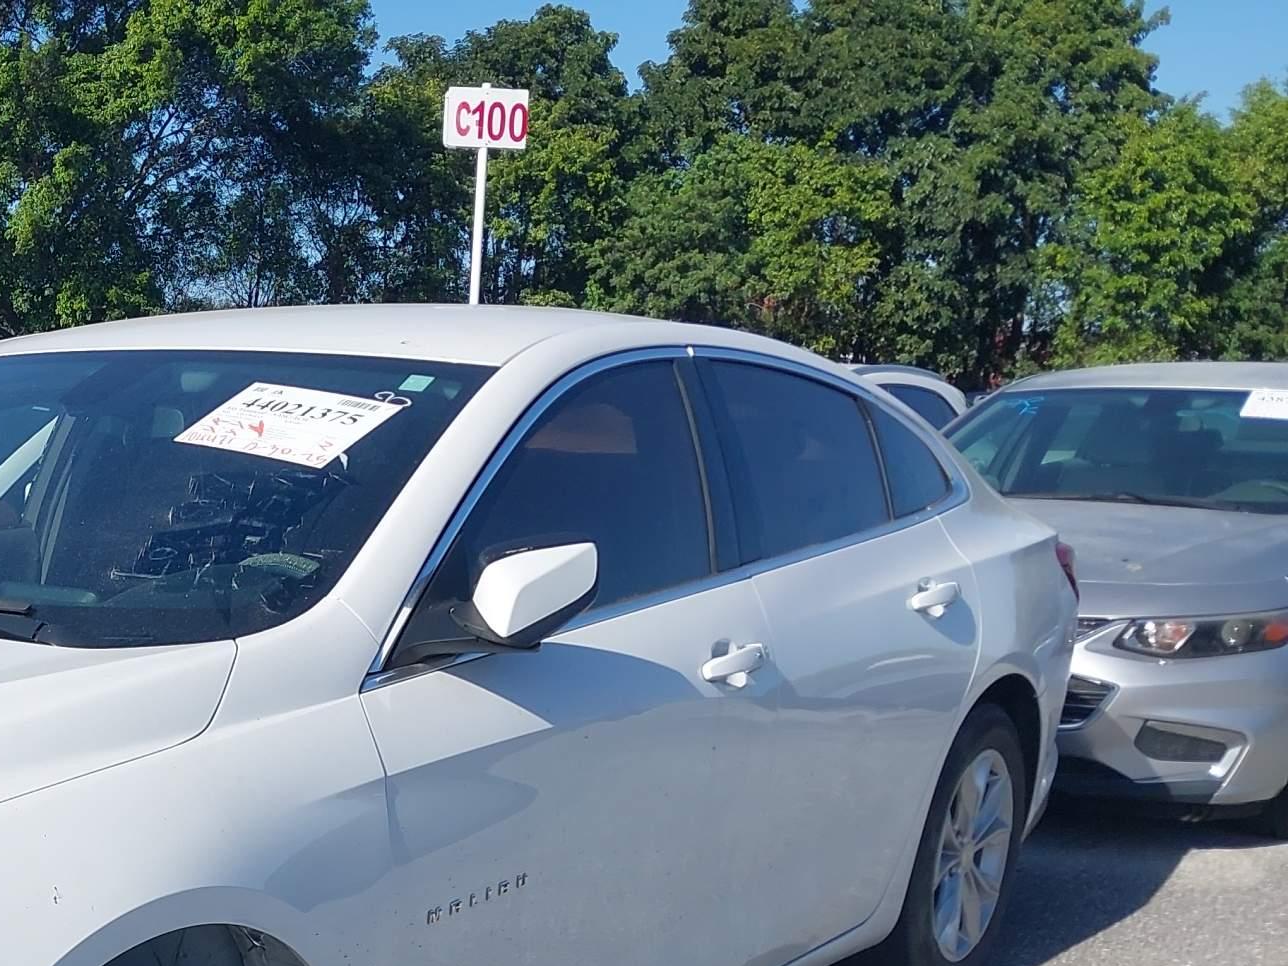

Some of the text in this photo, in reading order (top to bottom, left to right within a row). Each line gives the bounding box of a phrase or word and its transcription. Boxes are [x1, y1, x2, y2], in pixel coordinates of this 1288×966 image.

[456, 101, 528, 142] C100
[242, 397, 365, 426] 44021375
[426, 872, 528, 925] MALIBU
